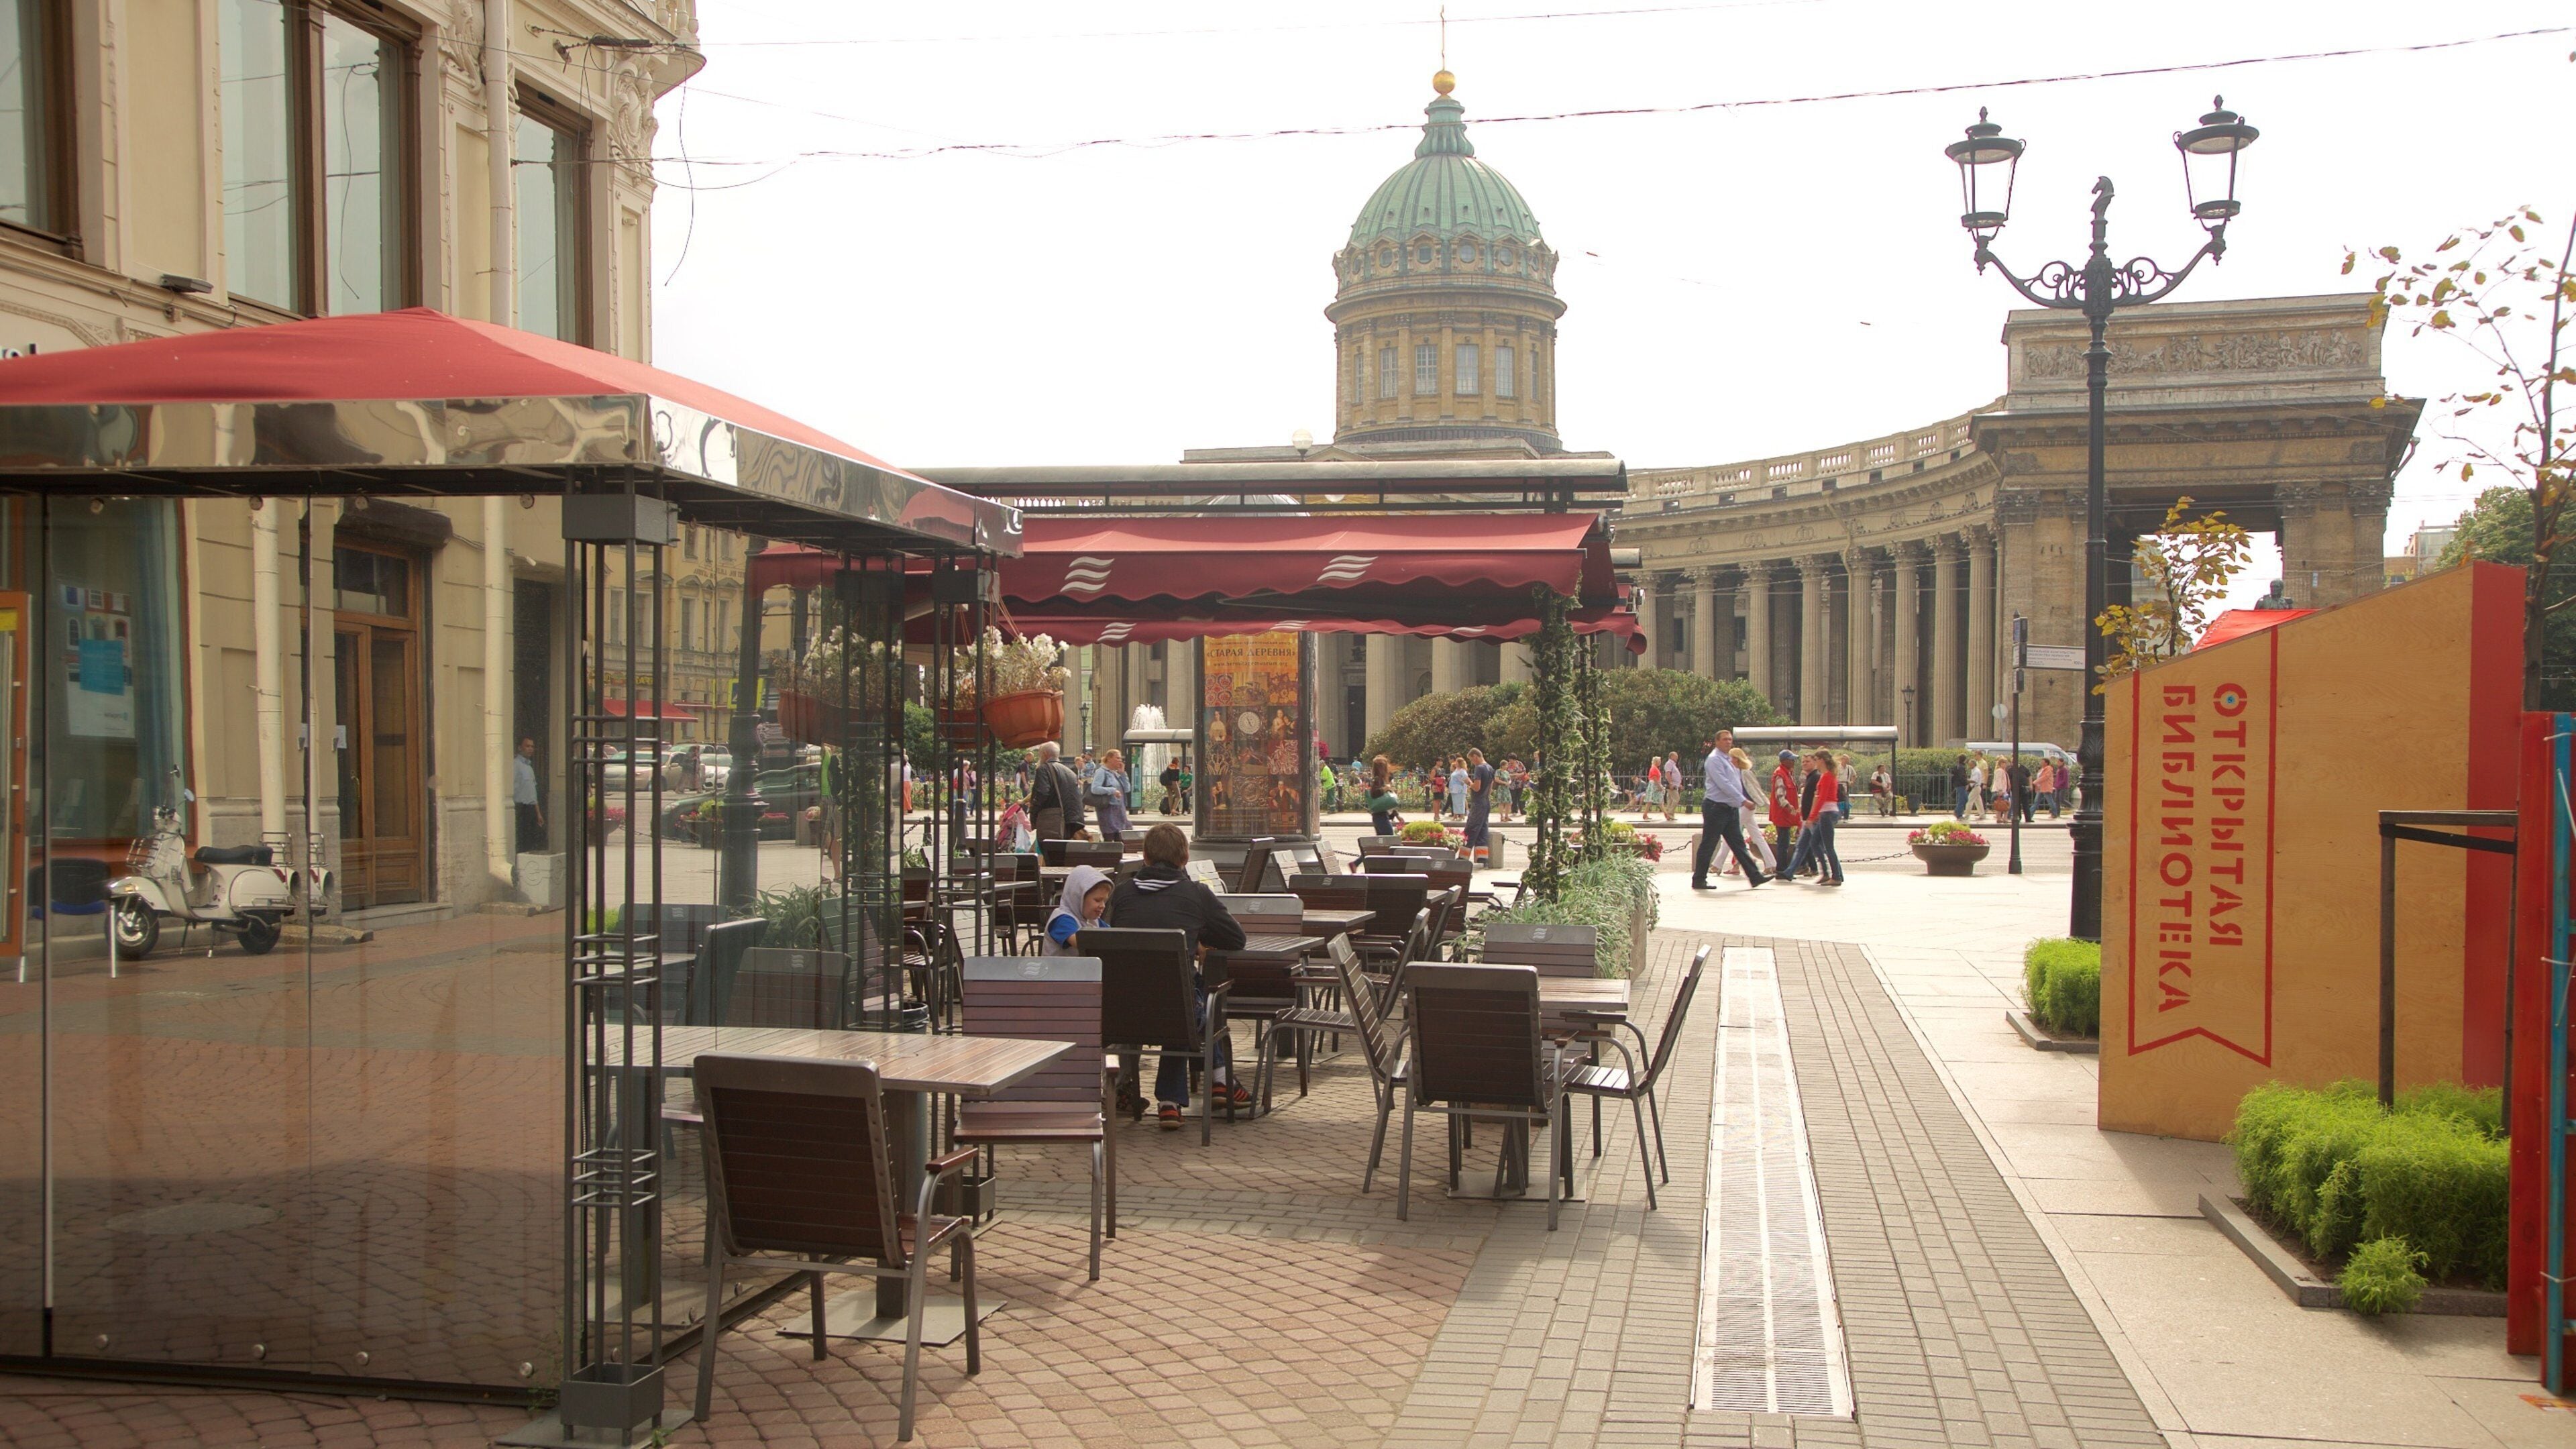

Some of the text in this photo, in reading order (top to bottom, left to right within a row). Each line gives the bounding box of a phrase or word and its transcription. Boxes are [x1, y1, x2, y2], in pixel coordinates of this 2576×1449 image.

[1207, 648, 1295, 657] «СТАРАЯ ДЕРЕВНЯ»
[2158, 686, 2196, 1013] БИБЛИОТЕКА
[2209, 683, 2247, 946] ОТКРЫТАЯ
